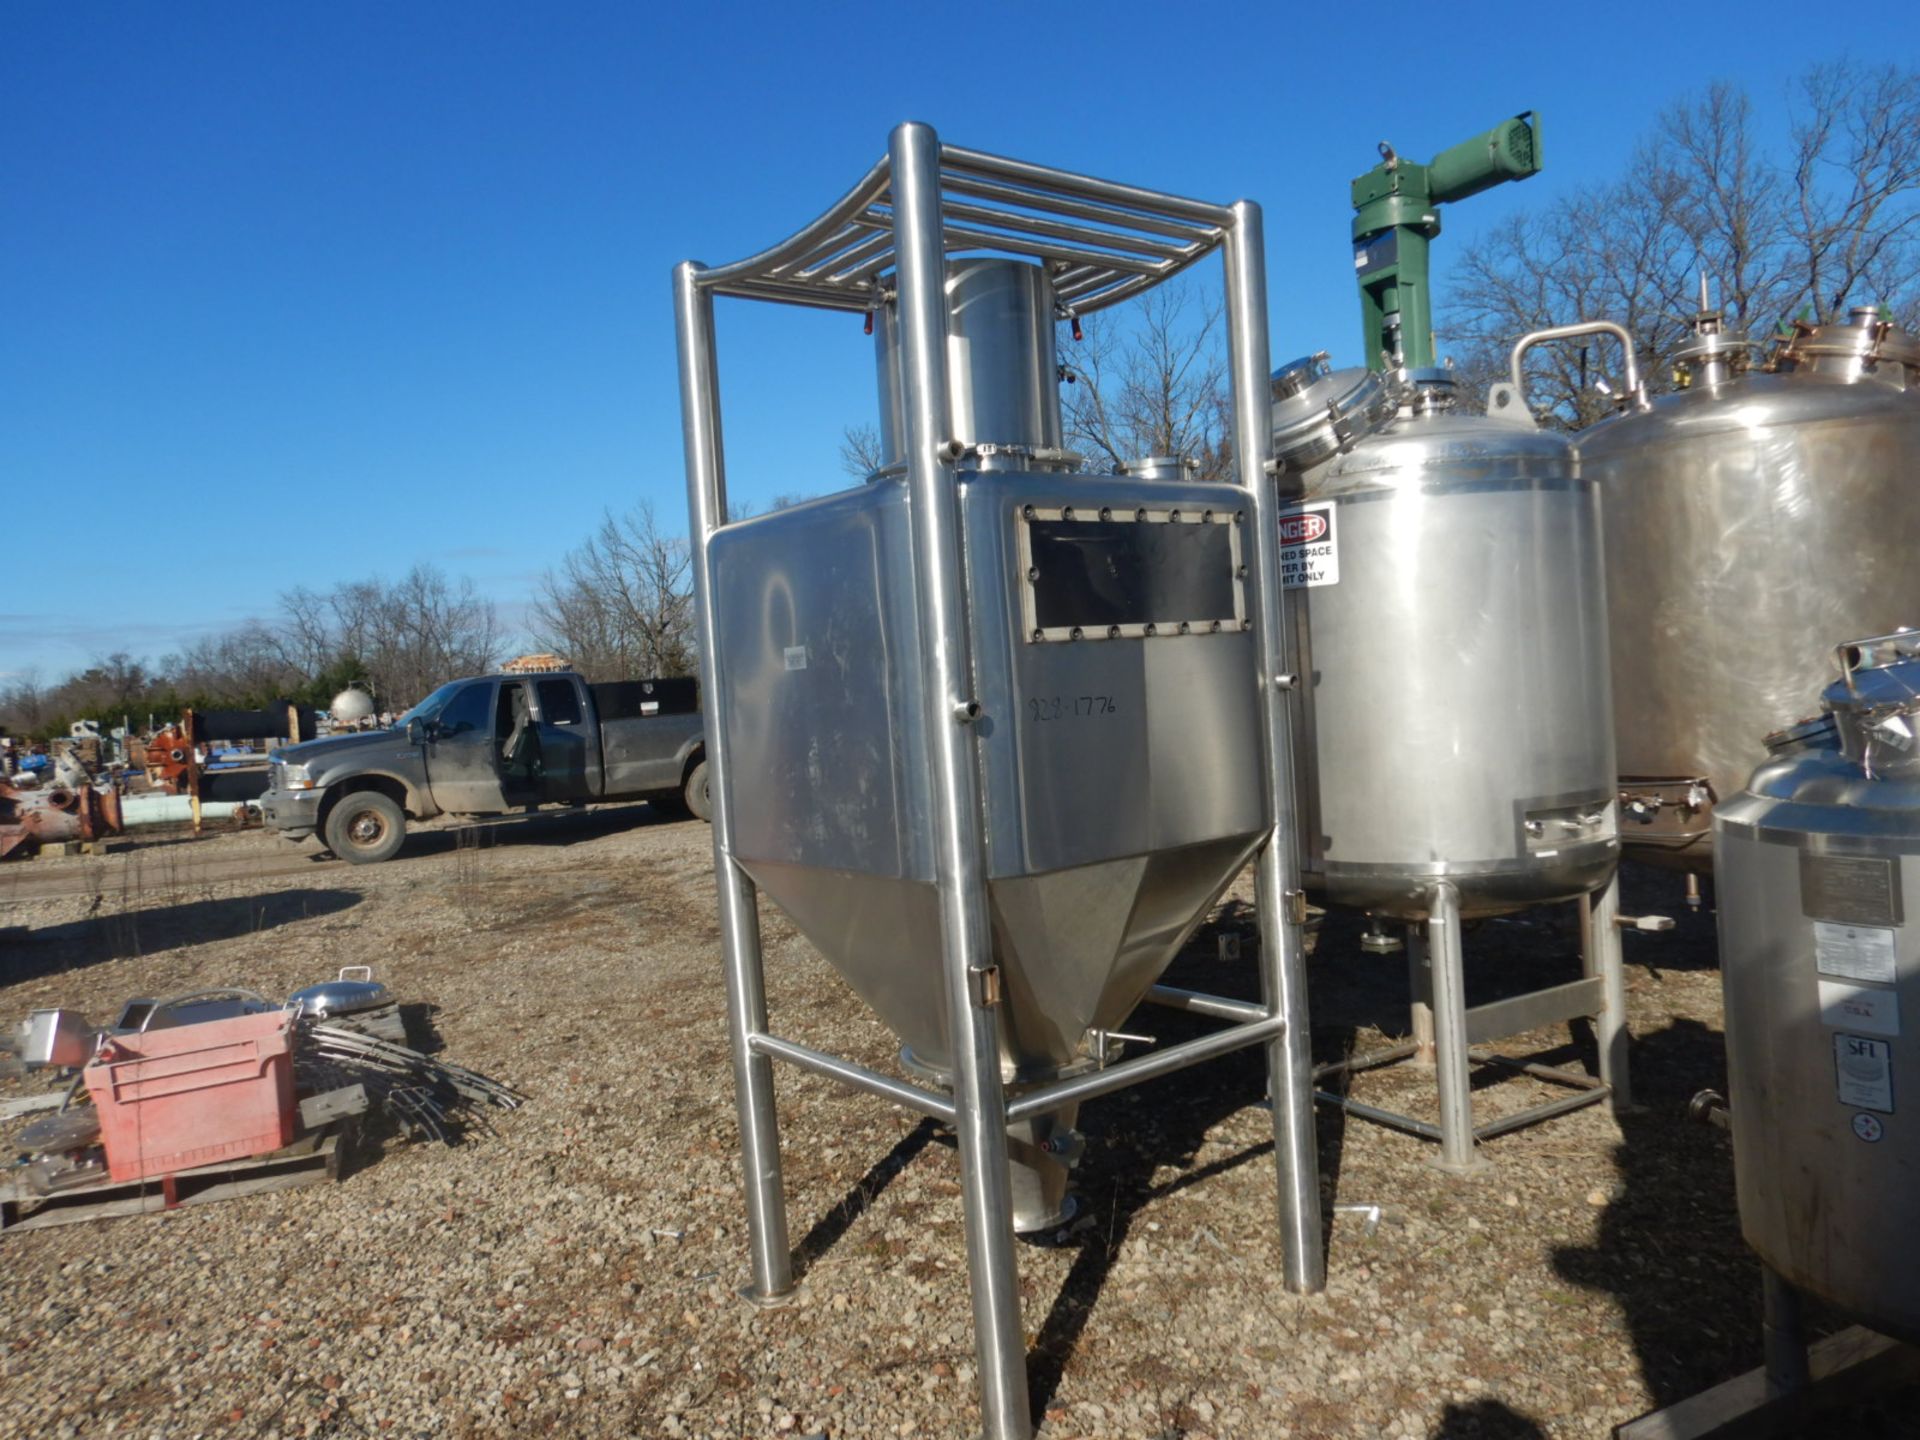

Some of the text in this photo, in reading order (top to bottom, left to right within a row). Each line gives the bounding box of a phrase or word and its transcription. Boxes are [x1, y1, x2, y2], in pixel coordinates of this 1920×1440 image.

[1299, 546, 1332, 558] SPACE
[1302, 561, 1315, 571] BY
[1298, 571, 1325, 583] ONLY
[1848, 1039, 1875, 1058] SFI
